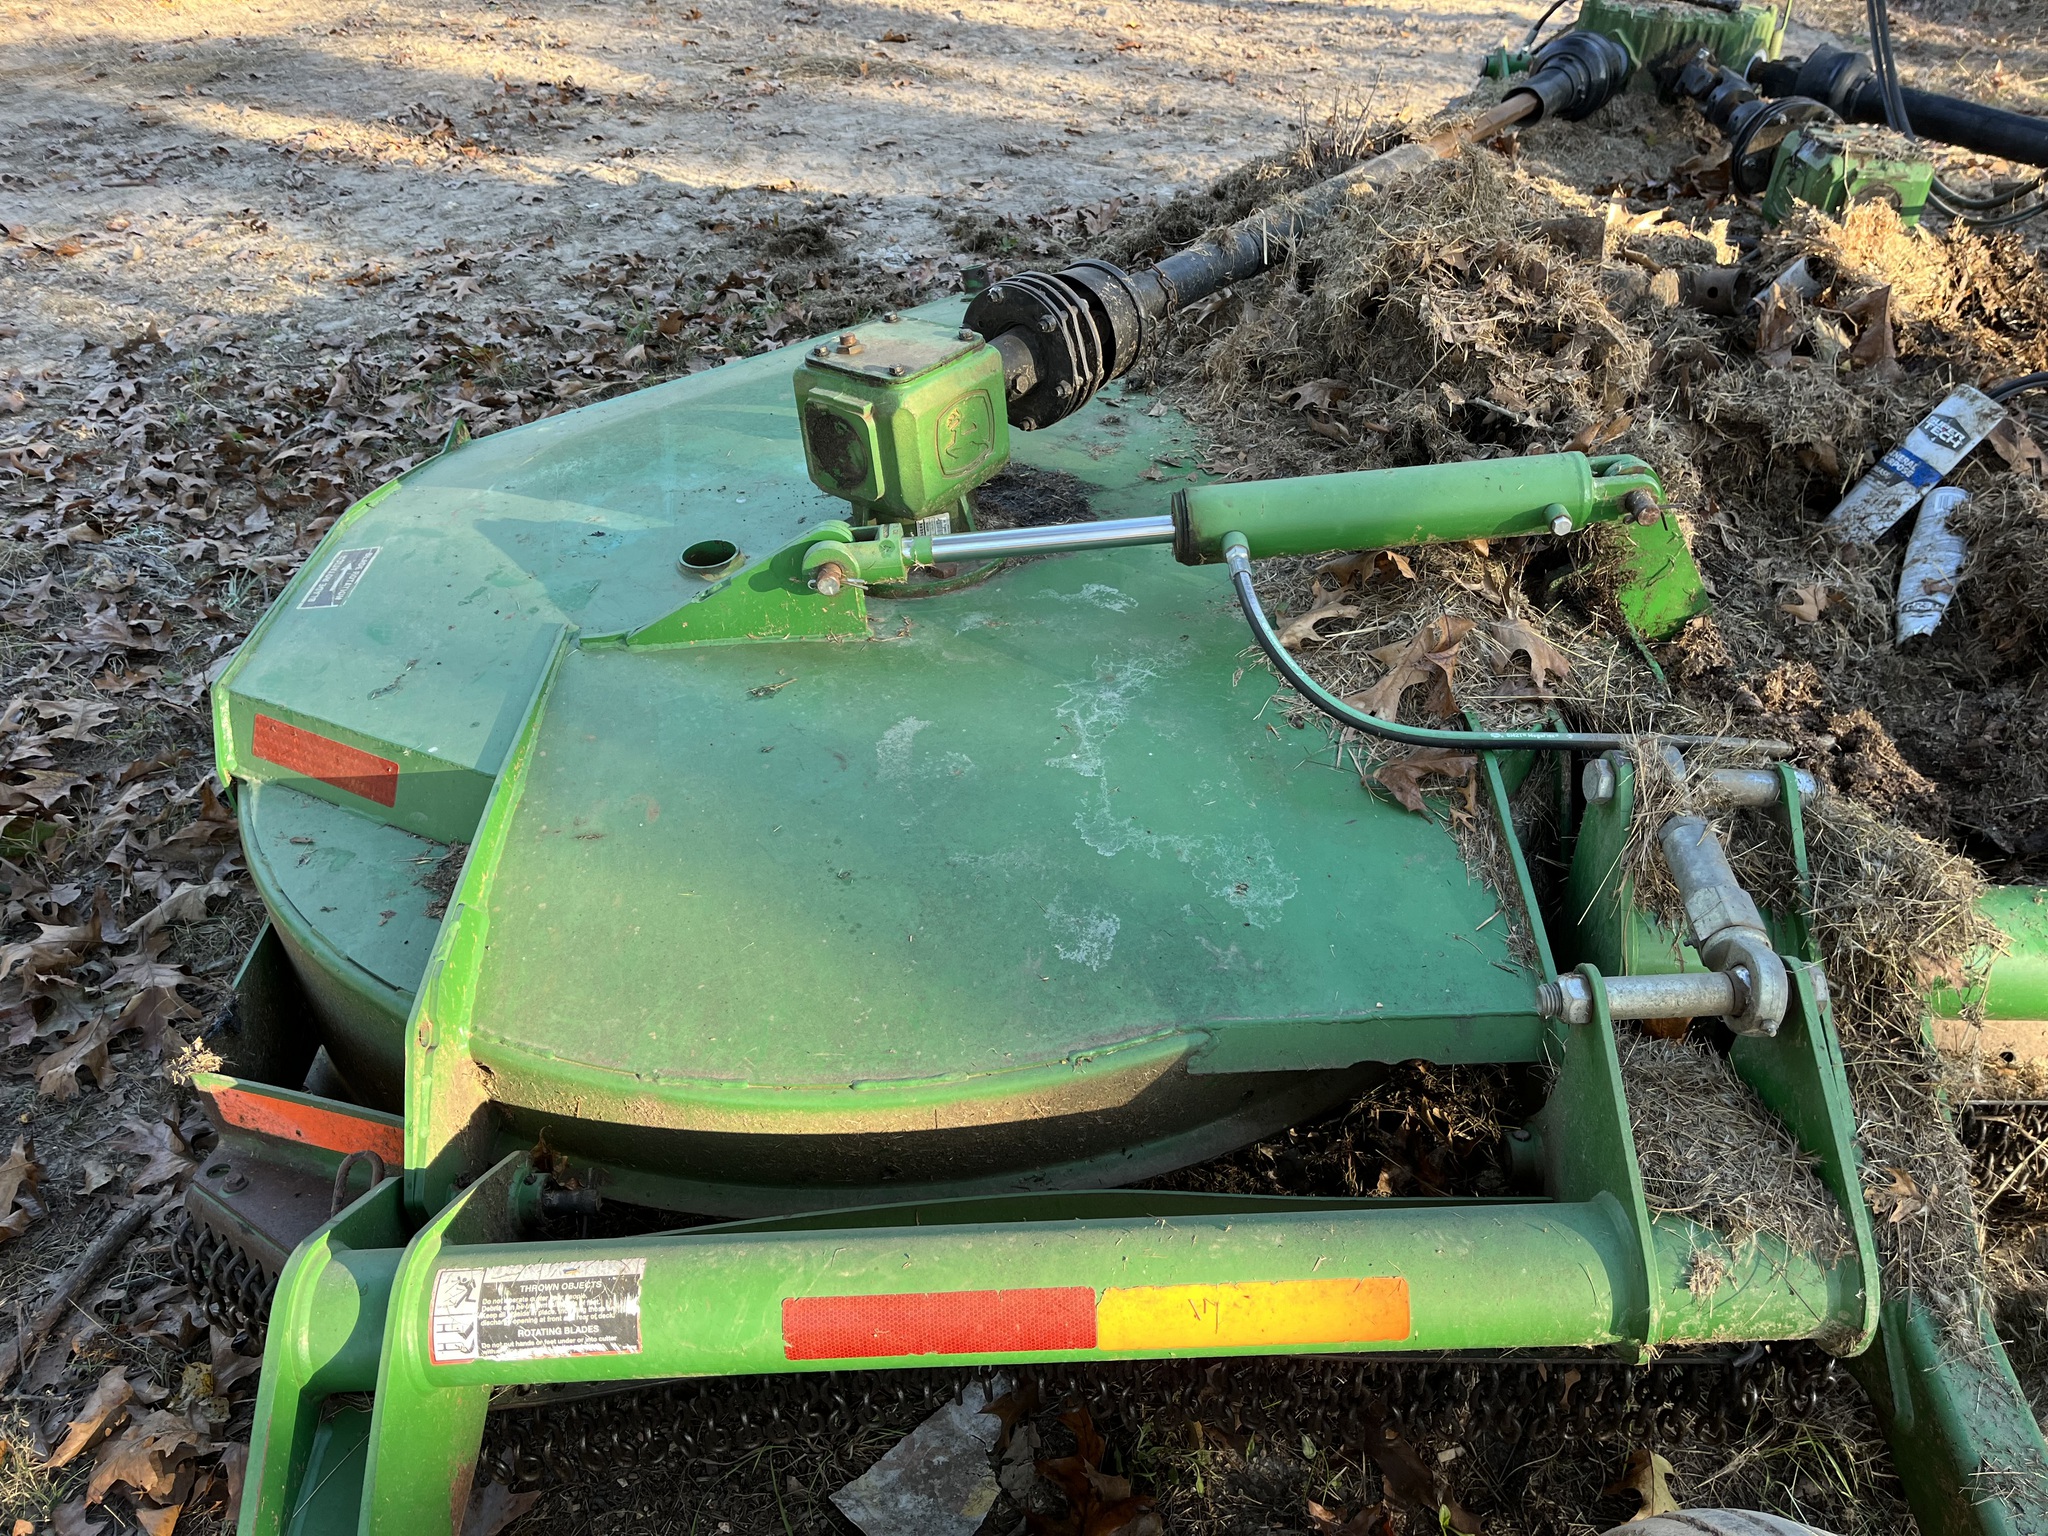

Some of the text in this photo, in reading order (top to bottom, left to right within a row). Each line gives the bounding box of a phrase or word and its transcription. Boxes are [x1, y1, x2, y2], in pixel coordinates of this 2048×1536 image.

[1924, 422, 1962, 449] TECH
[1926, 415, 1966, 441] SUPER
[1882, 456, 1915, 478] URPOSE
[1888, 449, 1919, 472] ENERAL
[520, 1280, 603, 1293] THROWN OBJECTS
[480, 1318, 511, 1327] dischar
[547, 1314, 563, 1322] front
[517, 1324, 600, 1338] ROTATING BLADES
[481, 1342, 491, 1350] Do
[491, 1341, 503, 1349] not
[515, 1339, 535, 1347] hands
[557, 1336, 577, 1345] under
